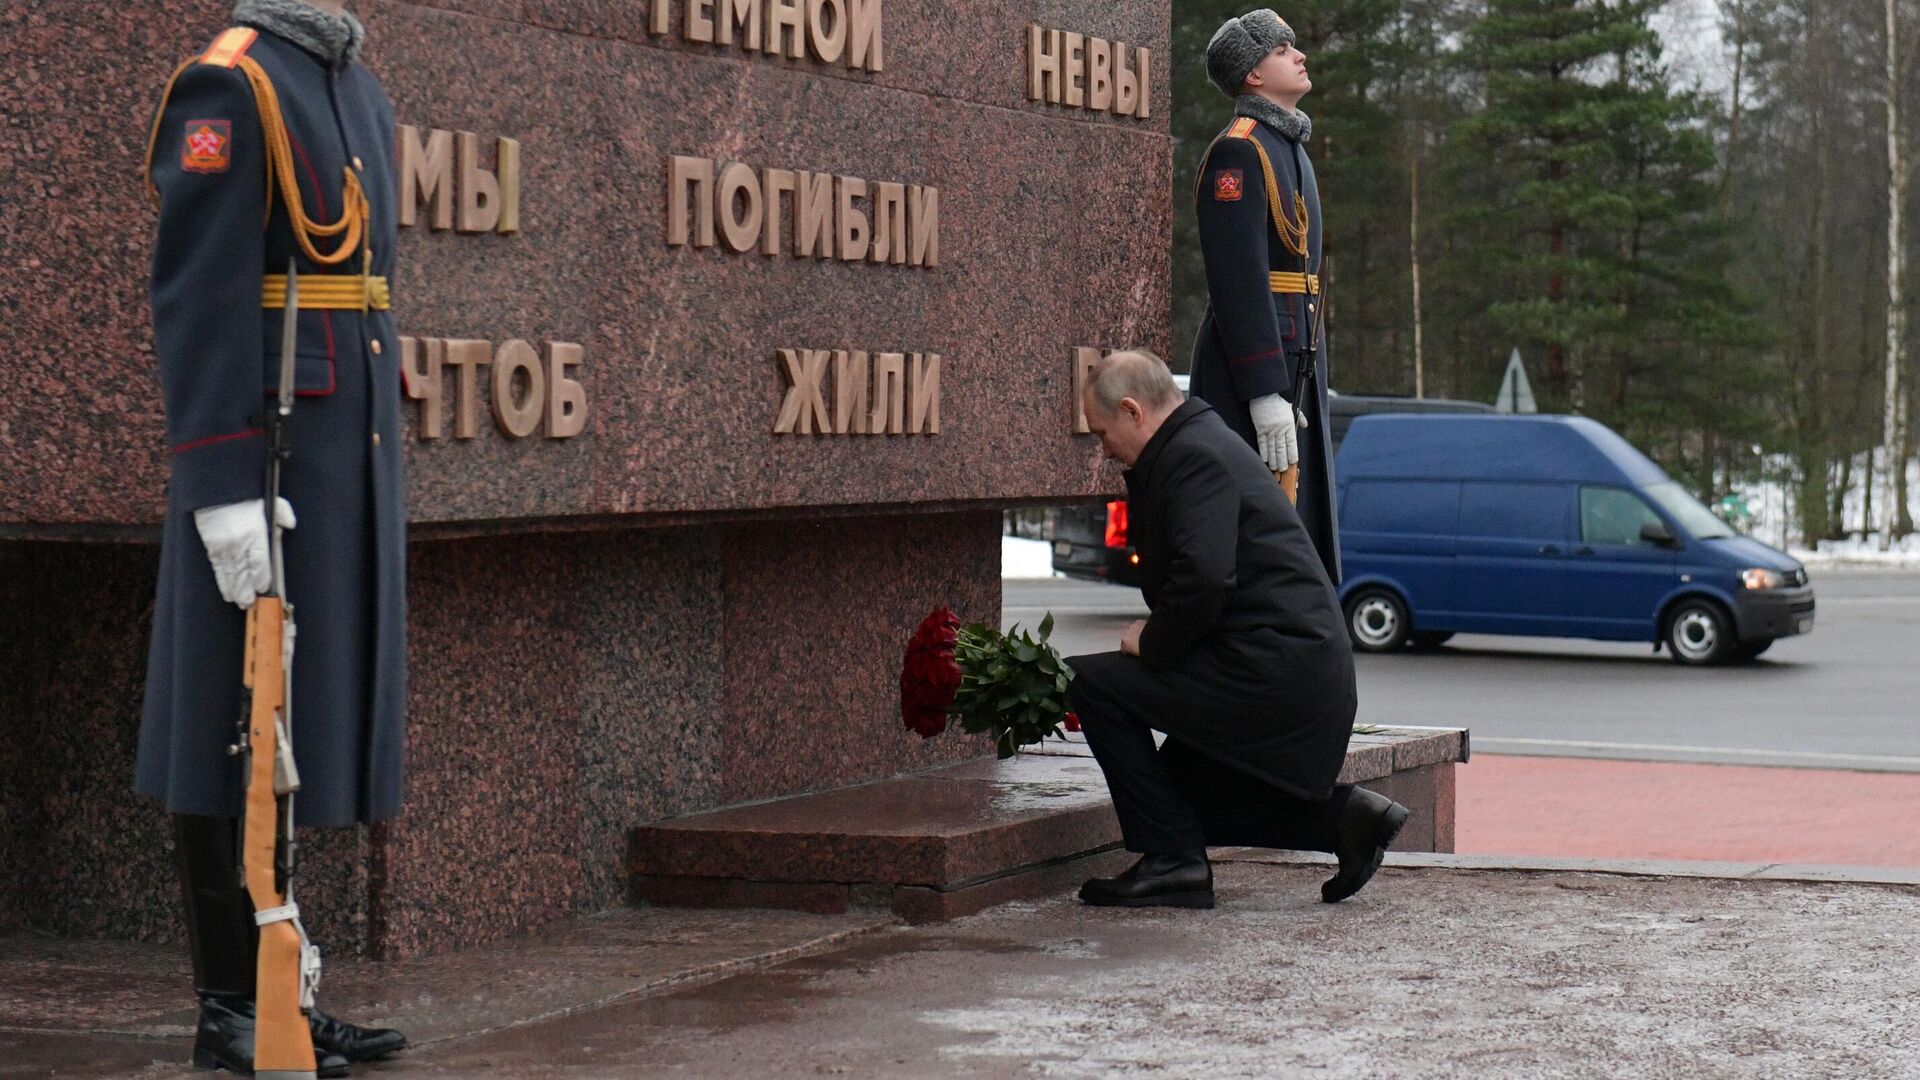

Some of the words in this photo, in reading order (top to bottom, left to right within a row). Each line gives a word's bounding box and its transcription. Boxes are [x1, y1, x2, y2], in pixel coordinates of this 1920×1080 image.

[1026, 24, 1149, 118] НЕВЫ
[396, 123, 520, 232] МЫ
[667, 154, 938, 267] ПОГИБЛИ
[398, 335, 588, 438] ЧТОБ
[773, 348, 940, 434] ЖИЛИ
